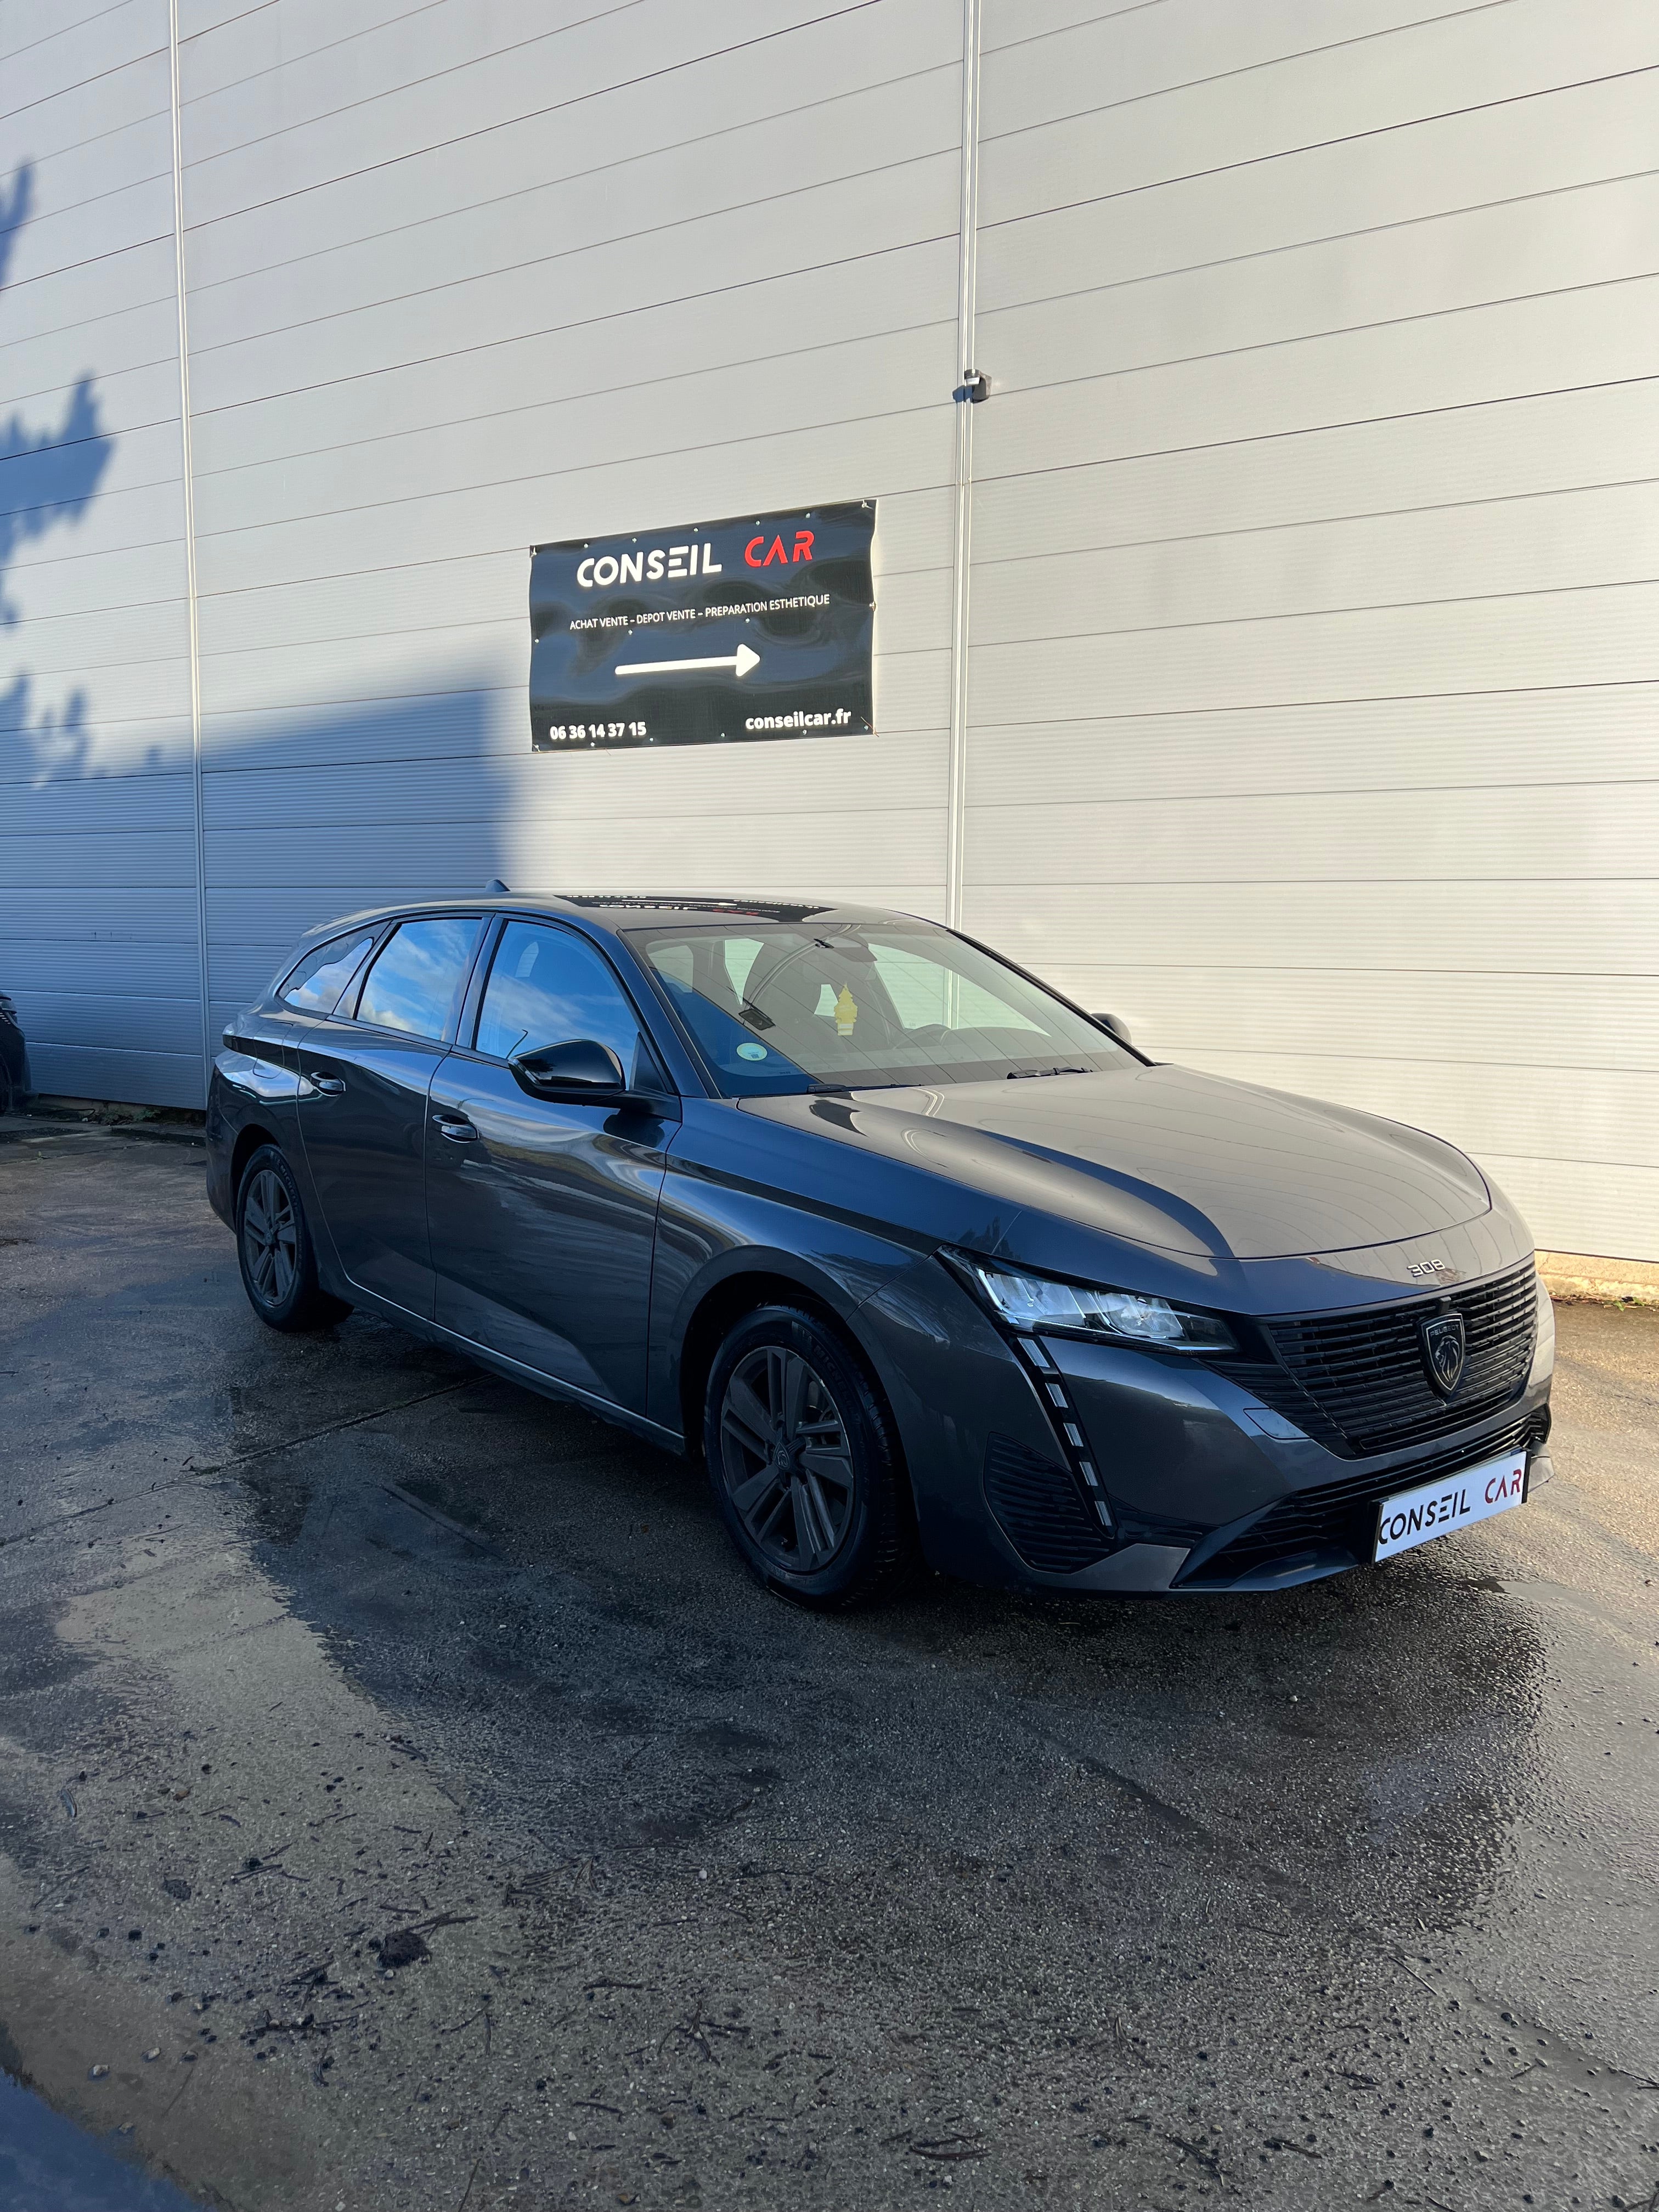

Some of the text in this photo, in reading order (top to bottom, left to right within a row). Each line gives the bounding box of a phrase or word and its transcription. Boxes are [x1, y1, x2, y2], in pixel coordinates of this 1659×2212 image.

[577, 531, 815, 587] CONSEIL CAR
[569, 618, 598, 630] ACHAT
[600, 616, 628, 628] VENTE
[636, 612, 665, 624] DEPOT
[667, 609, 696, 621] VENTE
[706, 601, 768, 618] PREPARATION
[770, 594, 830, 610] ESTHETIQUE
[745, 708, 851, 730] conseilcar.fr
[550, 721, 647, 740] 06 36 14 37 15
[1407, 1259, 1446, 1277] 308
[1430, 1324, 1459, 1338] PEUGEOT
[1378, 1468, 1522, 1545] CONSEIL CAR
